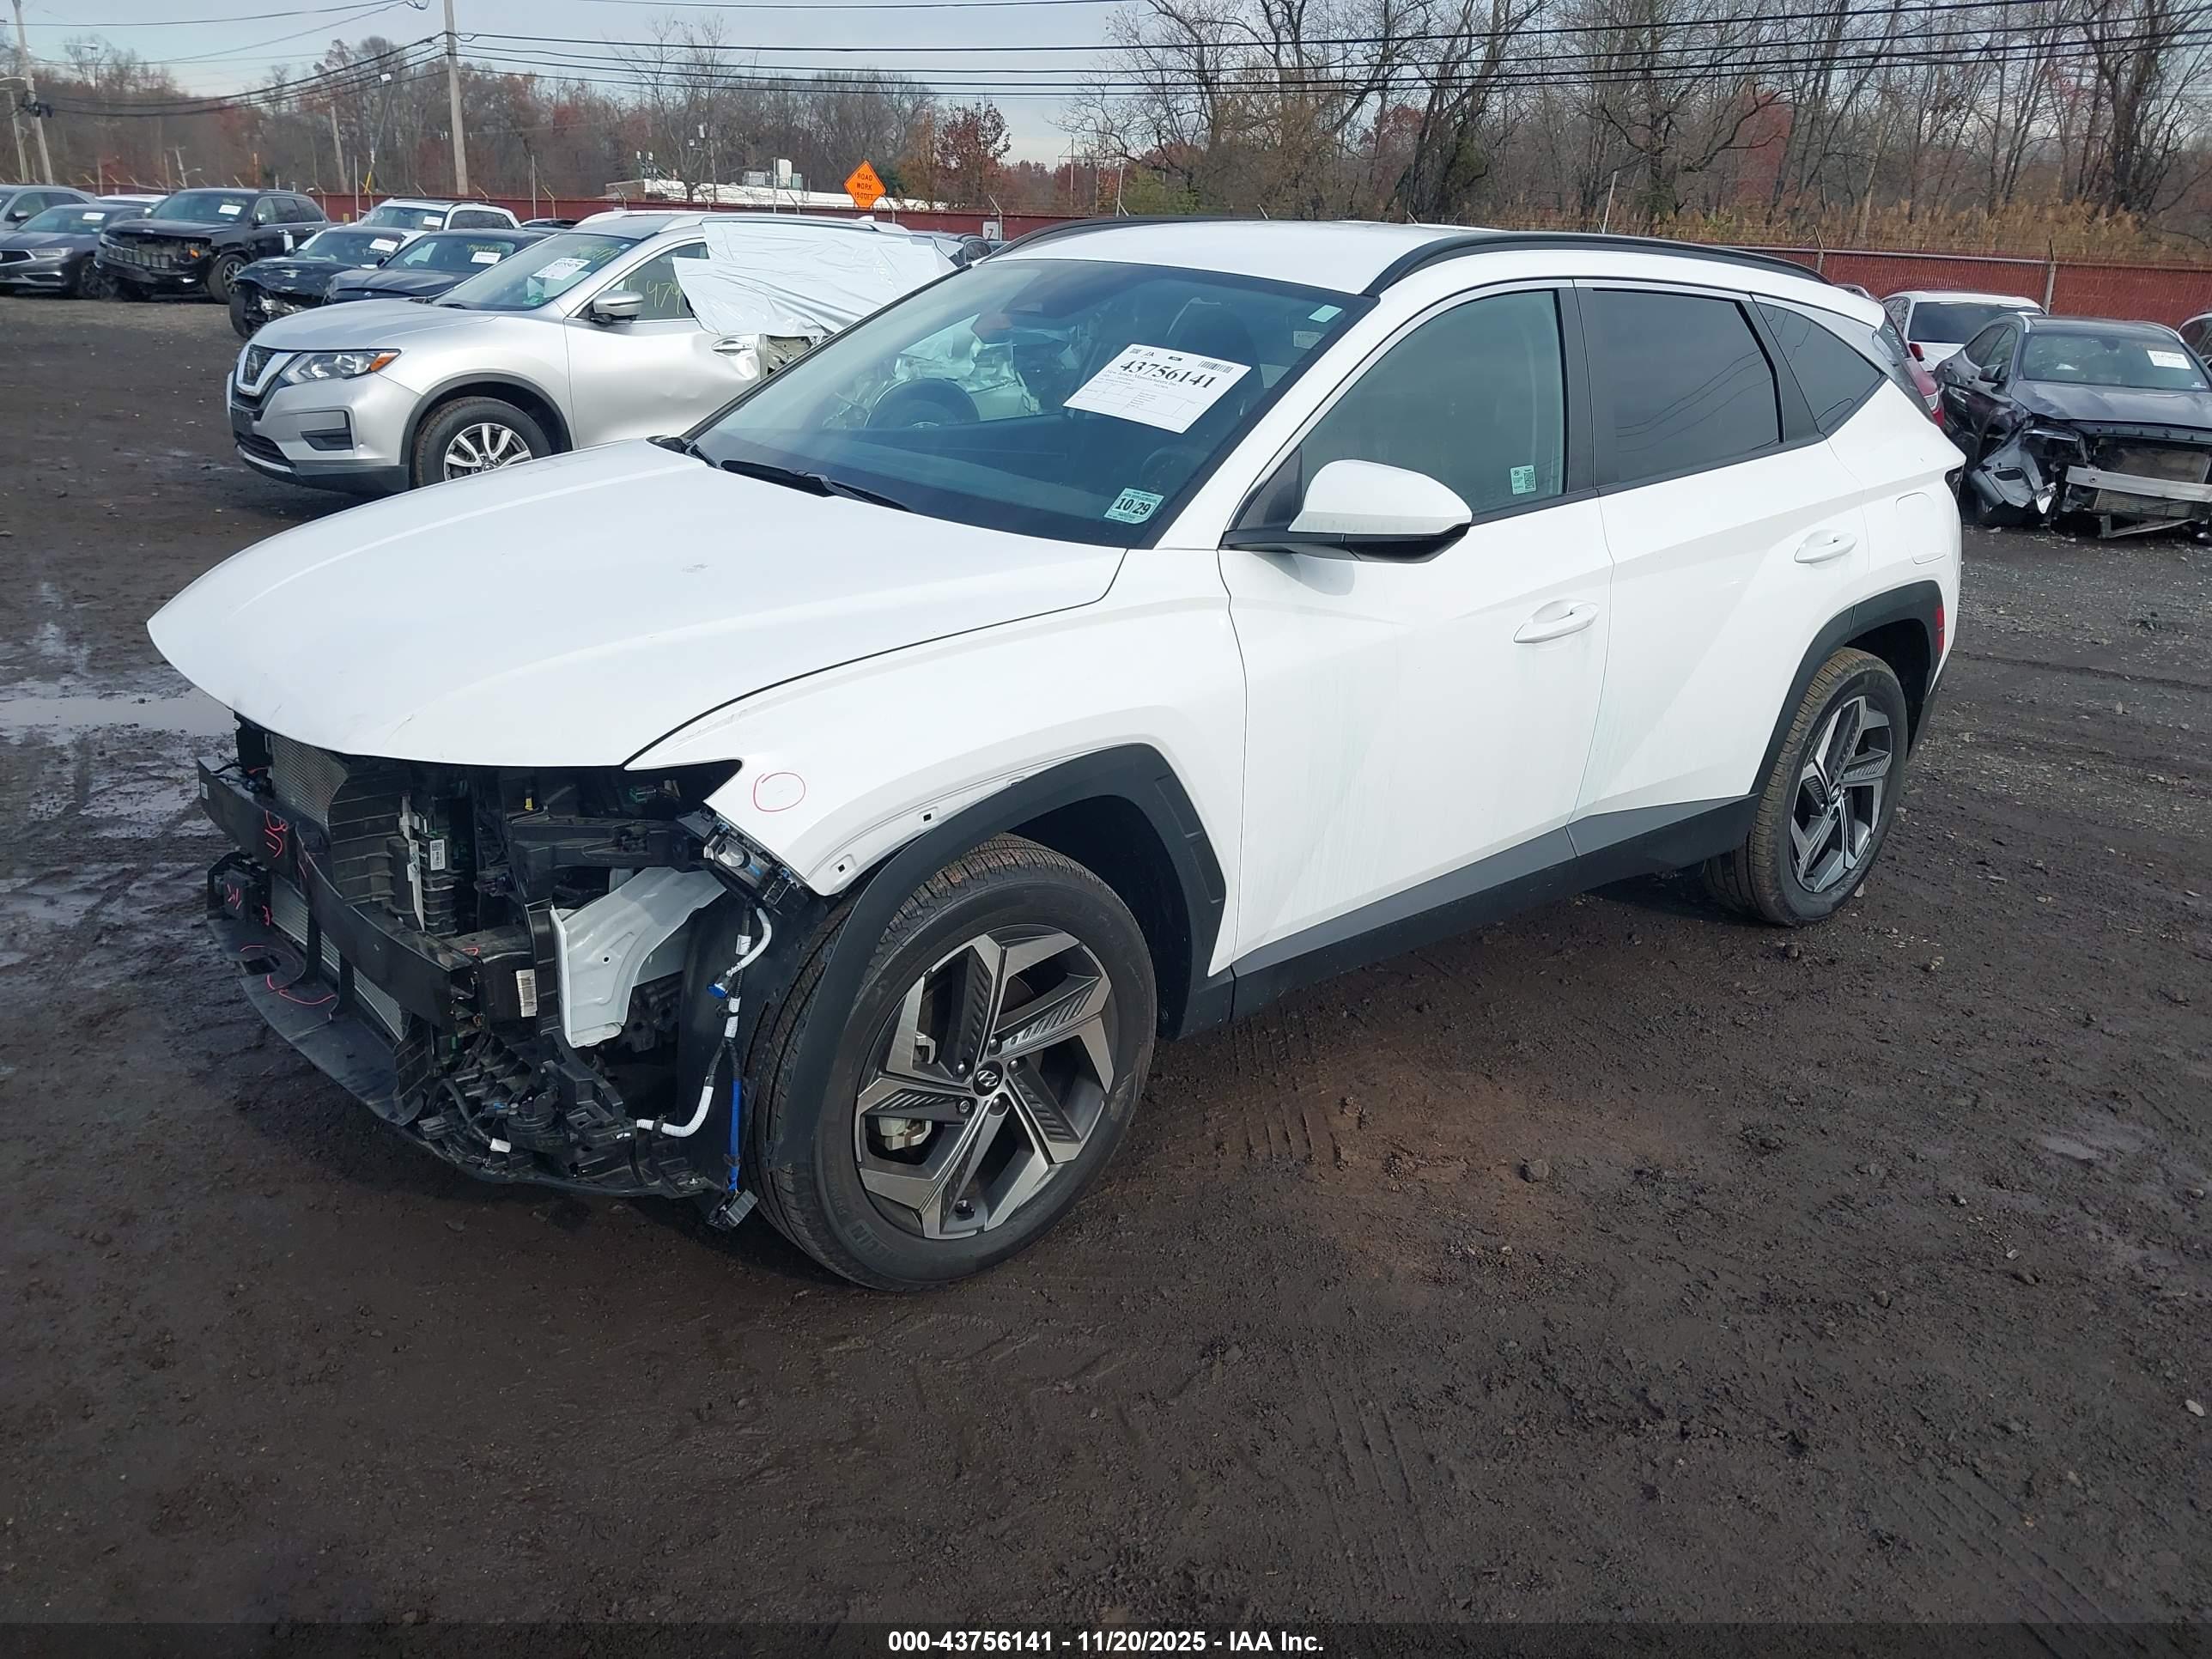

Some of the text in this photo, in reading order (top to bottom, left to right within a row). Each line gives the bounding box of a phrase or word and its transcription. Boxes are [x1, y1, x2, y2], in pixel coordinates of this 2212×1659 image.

[857, 173, 873, 181] ROAD
[988, 228, 994, 239] 7
[1120, 360, 1218, 388] 43756141
[1115, 497, 1134, 510] 10
[1132, 502, 1151, 515] 29
